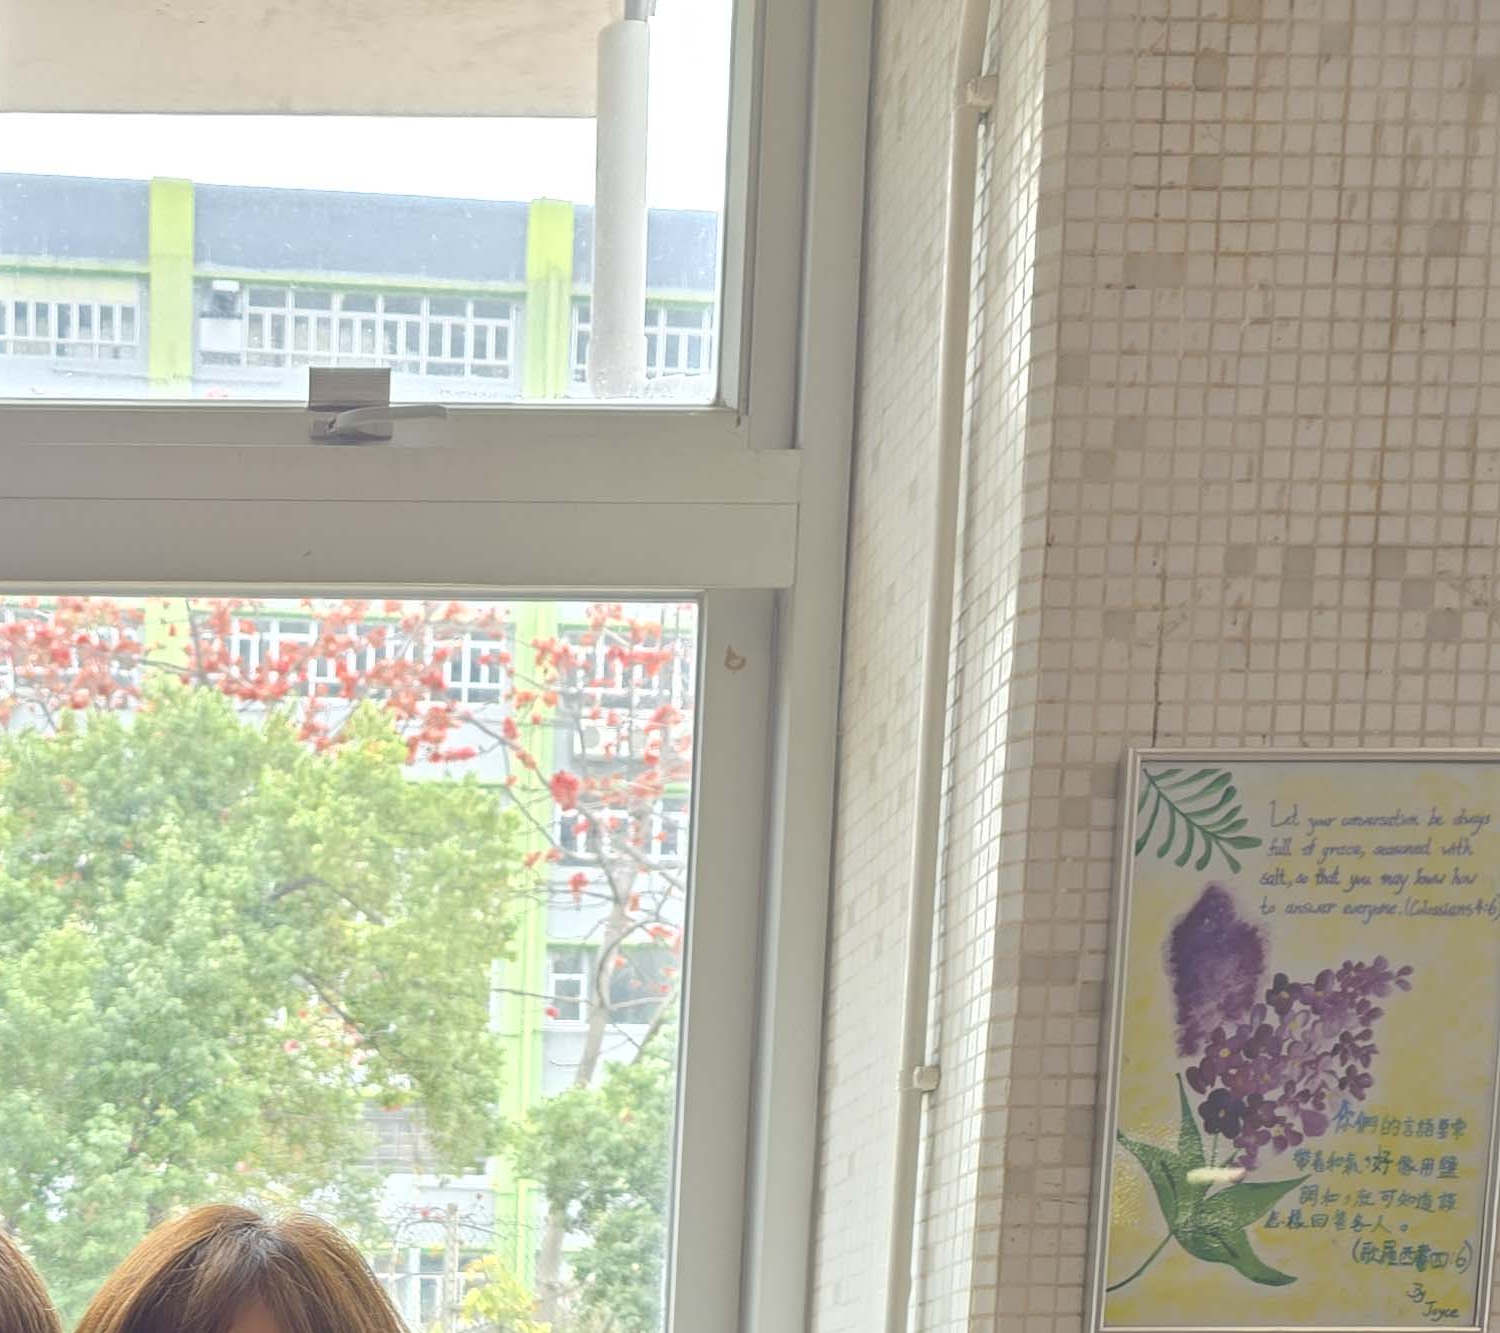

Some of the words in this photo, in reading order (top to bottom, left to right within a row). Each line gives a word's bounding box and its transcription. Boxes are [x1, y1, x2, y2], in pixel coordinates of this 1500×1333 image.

[1269, 800, 1299, 827] Let
[1428, 806, 1444, 827] be
[1268, 837, 1292, 856] full
[1315, 866, 1340, 885] that
[1342, 873, 1372, 893] you
[1380, 873, 1408, 894] may
[1260, 896, 1276, 915] to
[1285, 902, 1337, 915] answer
[1422, 1301, 1460, 1321] Joyce
